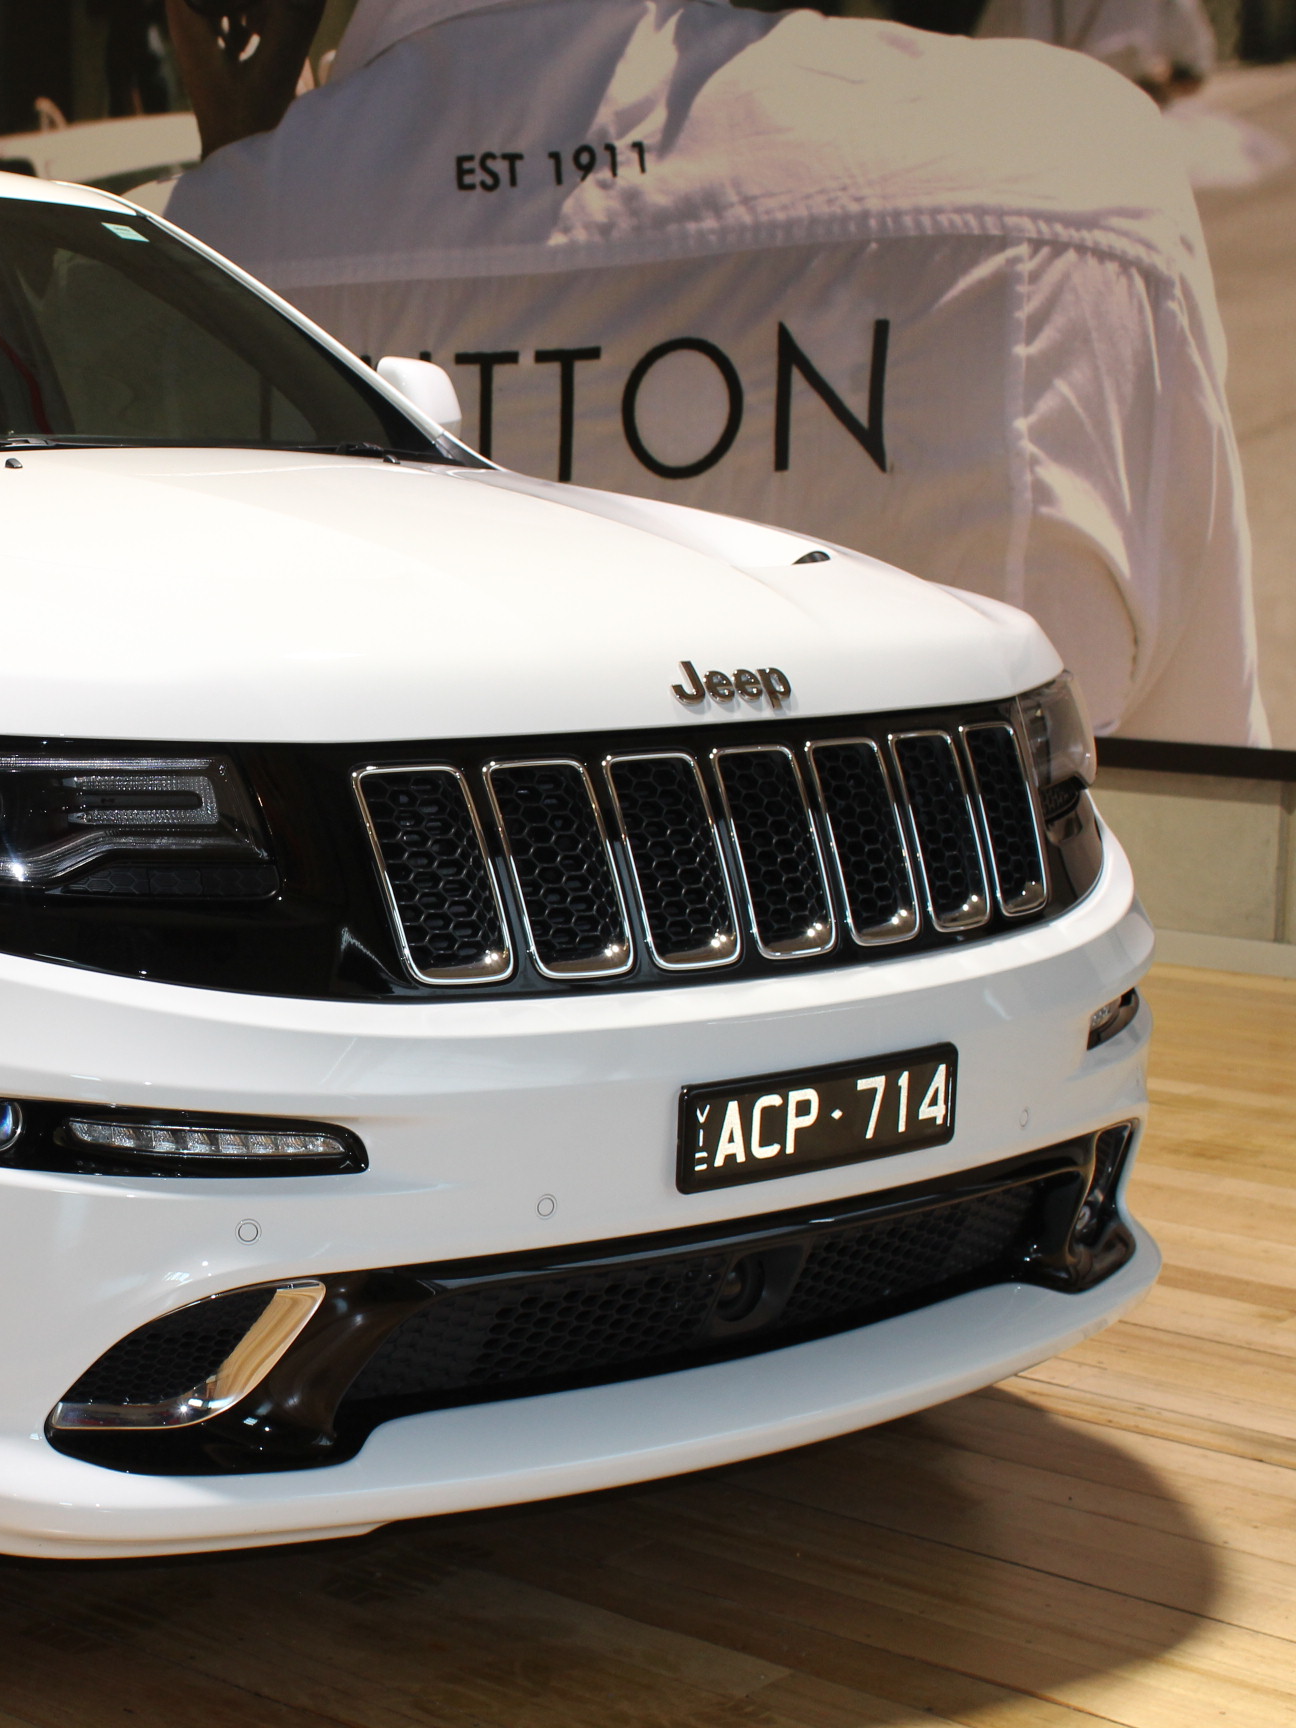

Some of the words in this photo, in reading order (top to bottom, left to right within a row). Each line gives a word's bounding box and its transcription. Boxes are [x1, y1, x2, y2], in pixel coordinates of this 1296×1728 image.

[455, 152, 525, 192] EST
[547, 140, 648, 187] 1911
[671, 660, 792, 710] Jeep
